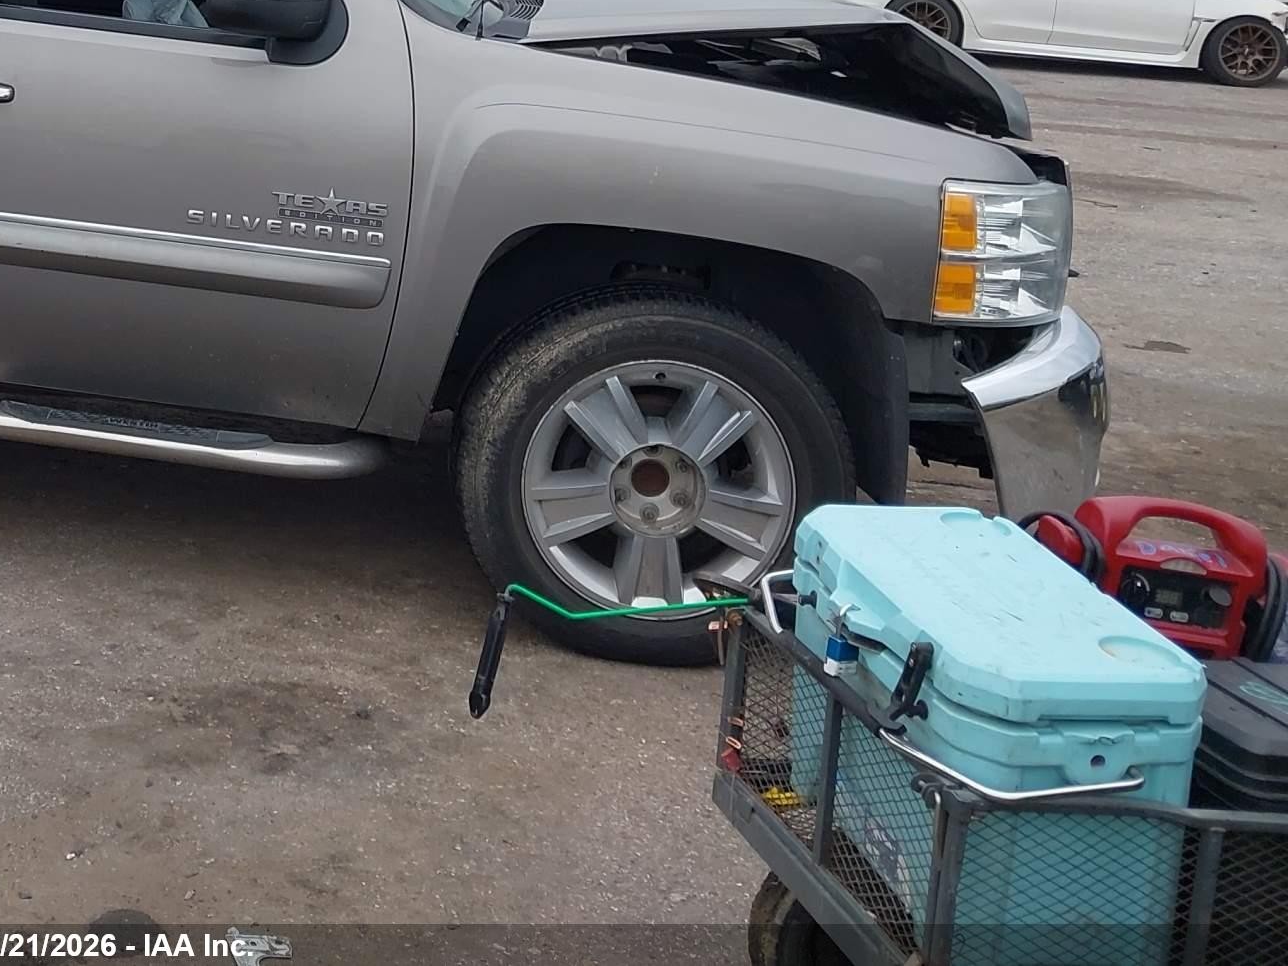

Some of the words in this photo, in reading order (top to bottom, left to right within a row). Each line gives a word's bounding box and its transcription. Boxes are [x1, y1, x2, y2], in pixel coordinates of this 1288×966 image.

[272, 187, 388, 217] TEXAS
[186, 209, 385, 246] SILVERADO
[284, 209, 378, 227] EDITION
